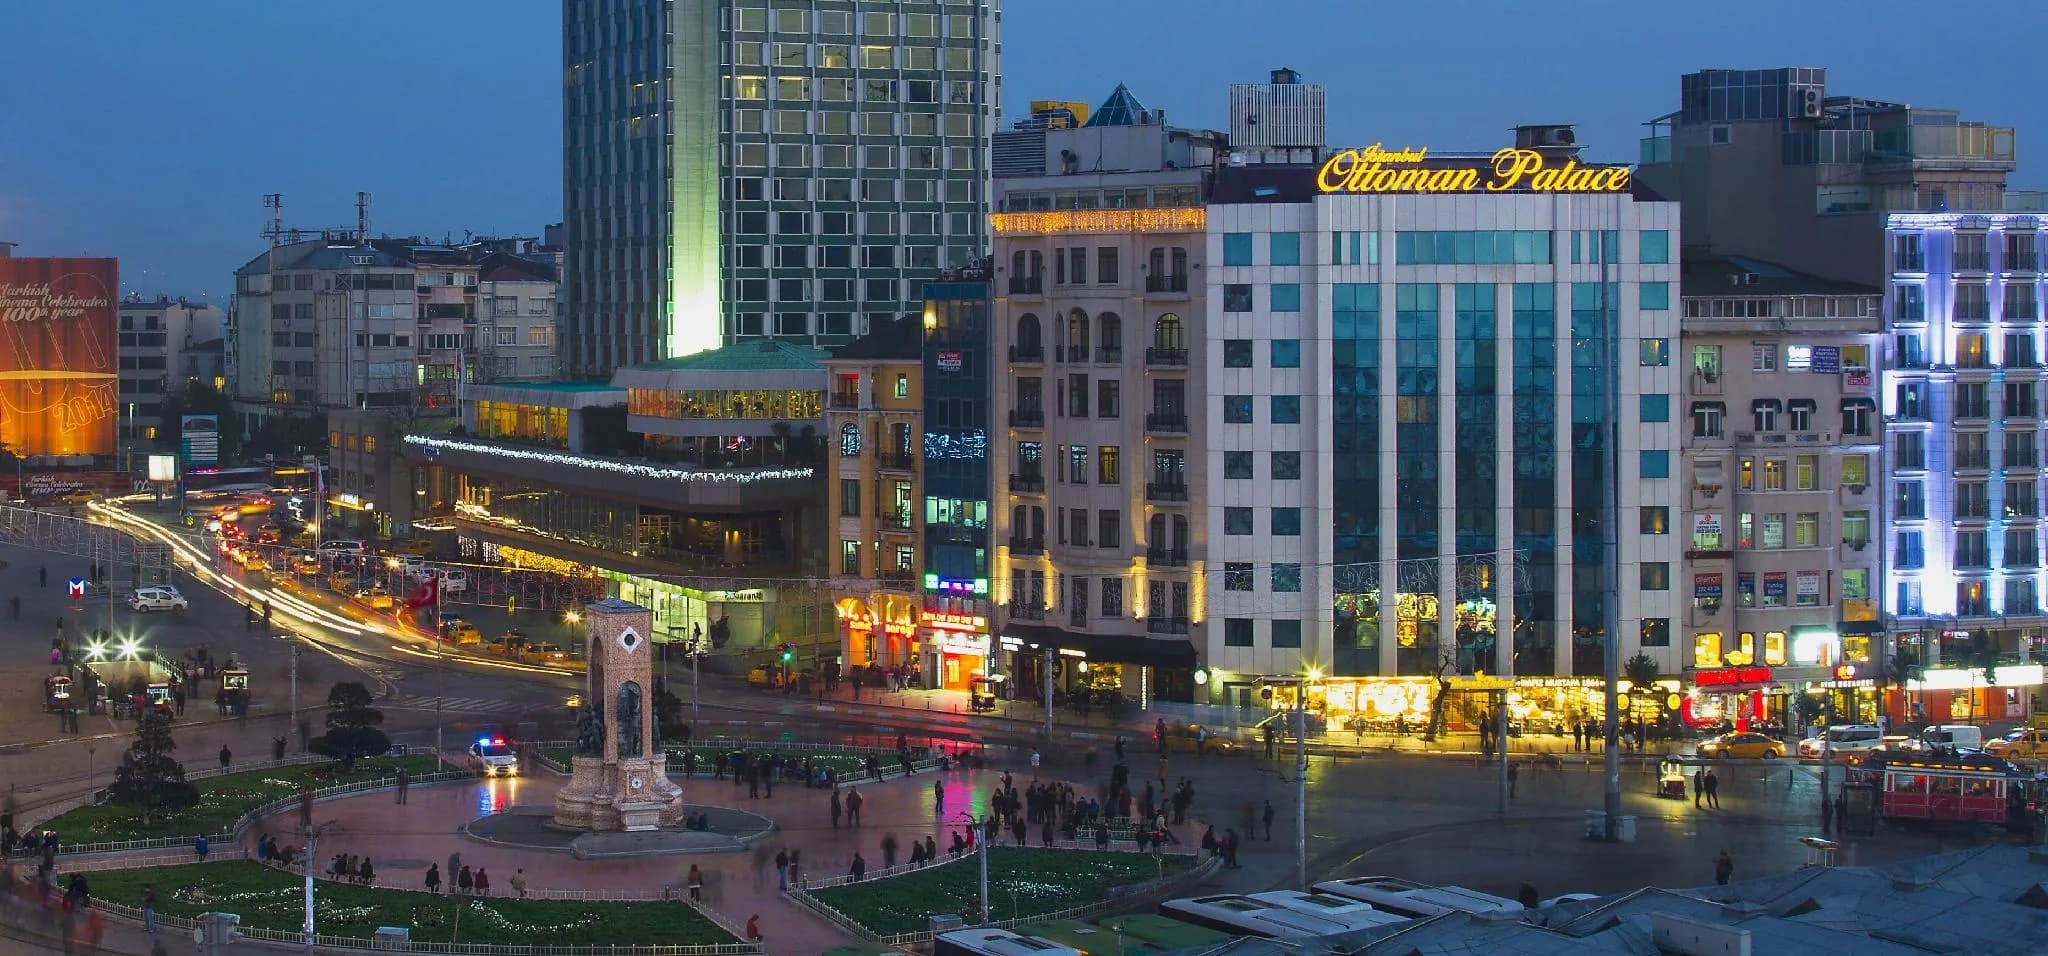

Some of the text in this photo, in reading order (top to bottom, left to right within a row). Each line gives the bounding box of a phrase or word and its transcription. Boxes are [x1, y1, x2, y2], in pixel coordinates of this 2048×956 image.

[1317, 146, 1632, 193] Ottoman Palace
[0, 282, 51, 297] Turkish
[0, 294, 108, 308] inema Celebrates
[50, 308, 86, 320] year
[52, 384, 119, 434] 2014
[69, 580, 85, 595] M
